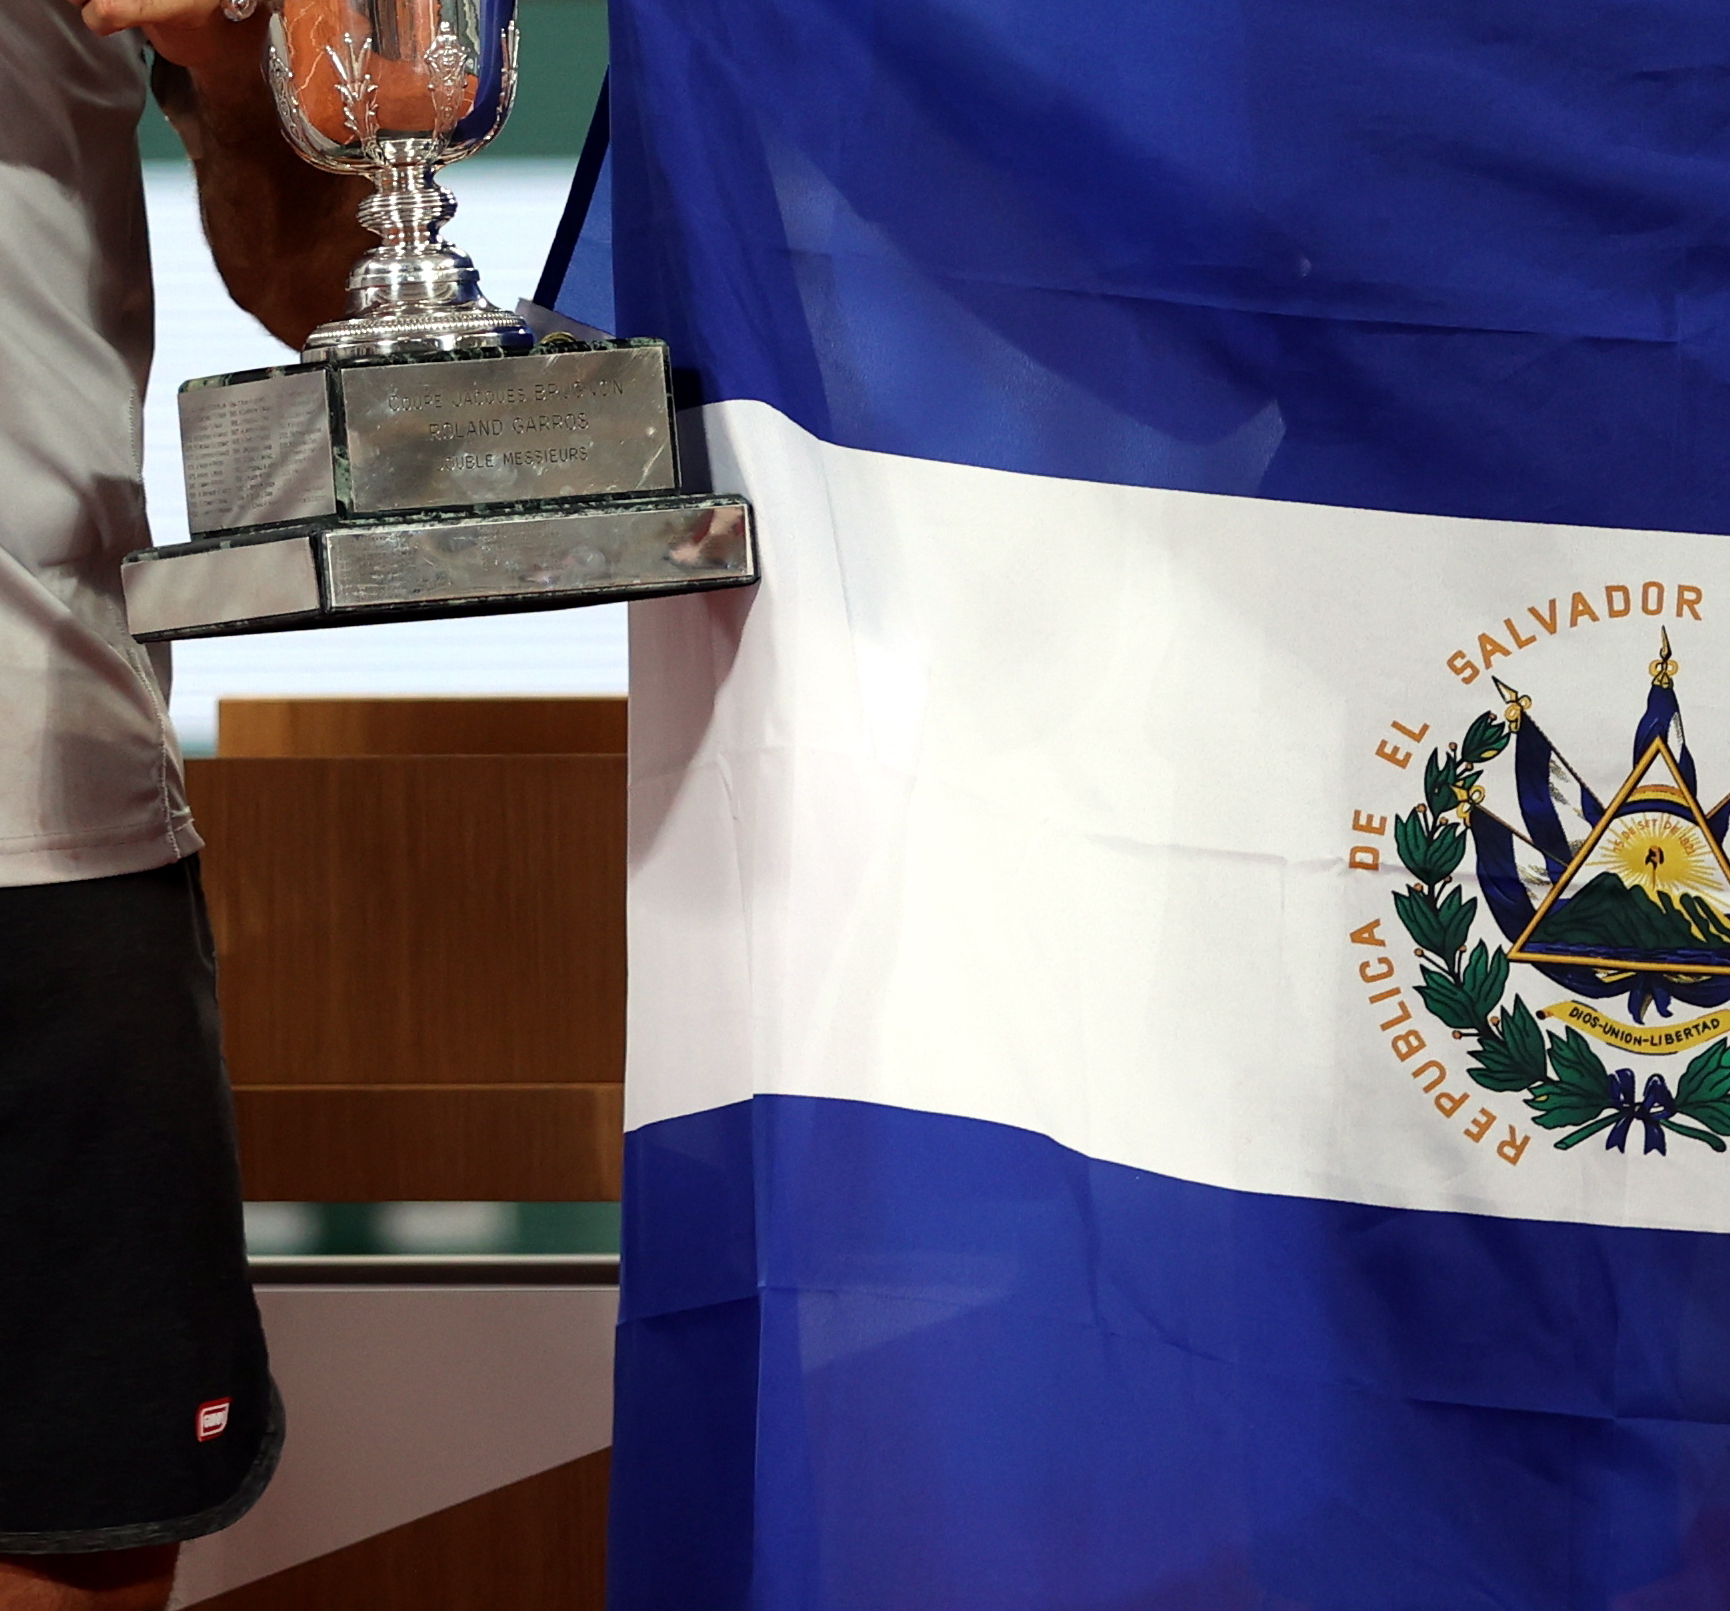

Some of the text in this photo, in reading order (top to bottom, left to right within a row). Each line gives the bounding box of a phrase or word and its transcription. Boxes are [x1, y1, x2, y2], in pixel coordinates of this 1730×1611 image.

[388, 393, 443, 413] COUPE
[451, 388, 526, 408] JACQUES
[428, 411, 590, 442] ROLAND GARROS
[502, 445, 589, 467] MESSIEURS
[1446, 581, 1703, 684] SALVADOR
[1375, 720, 1430, 769] EL
[1349, 809, 1388, 871] DE
[1638, 819, 1658, 830] SET
[1350, 918, 1531, 1166] REPUBLICA
[1569, 1006, 1721, 1046] DIOS-UNION-LIBERTAD
